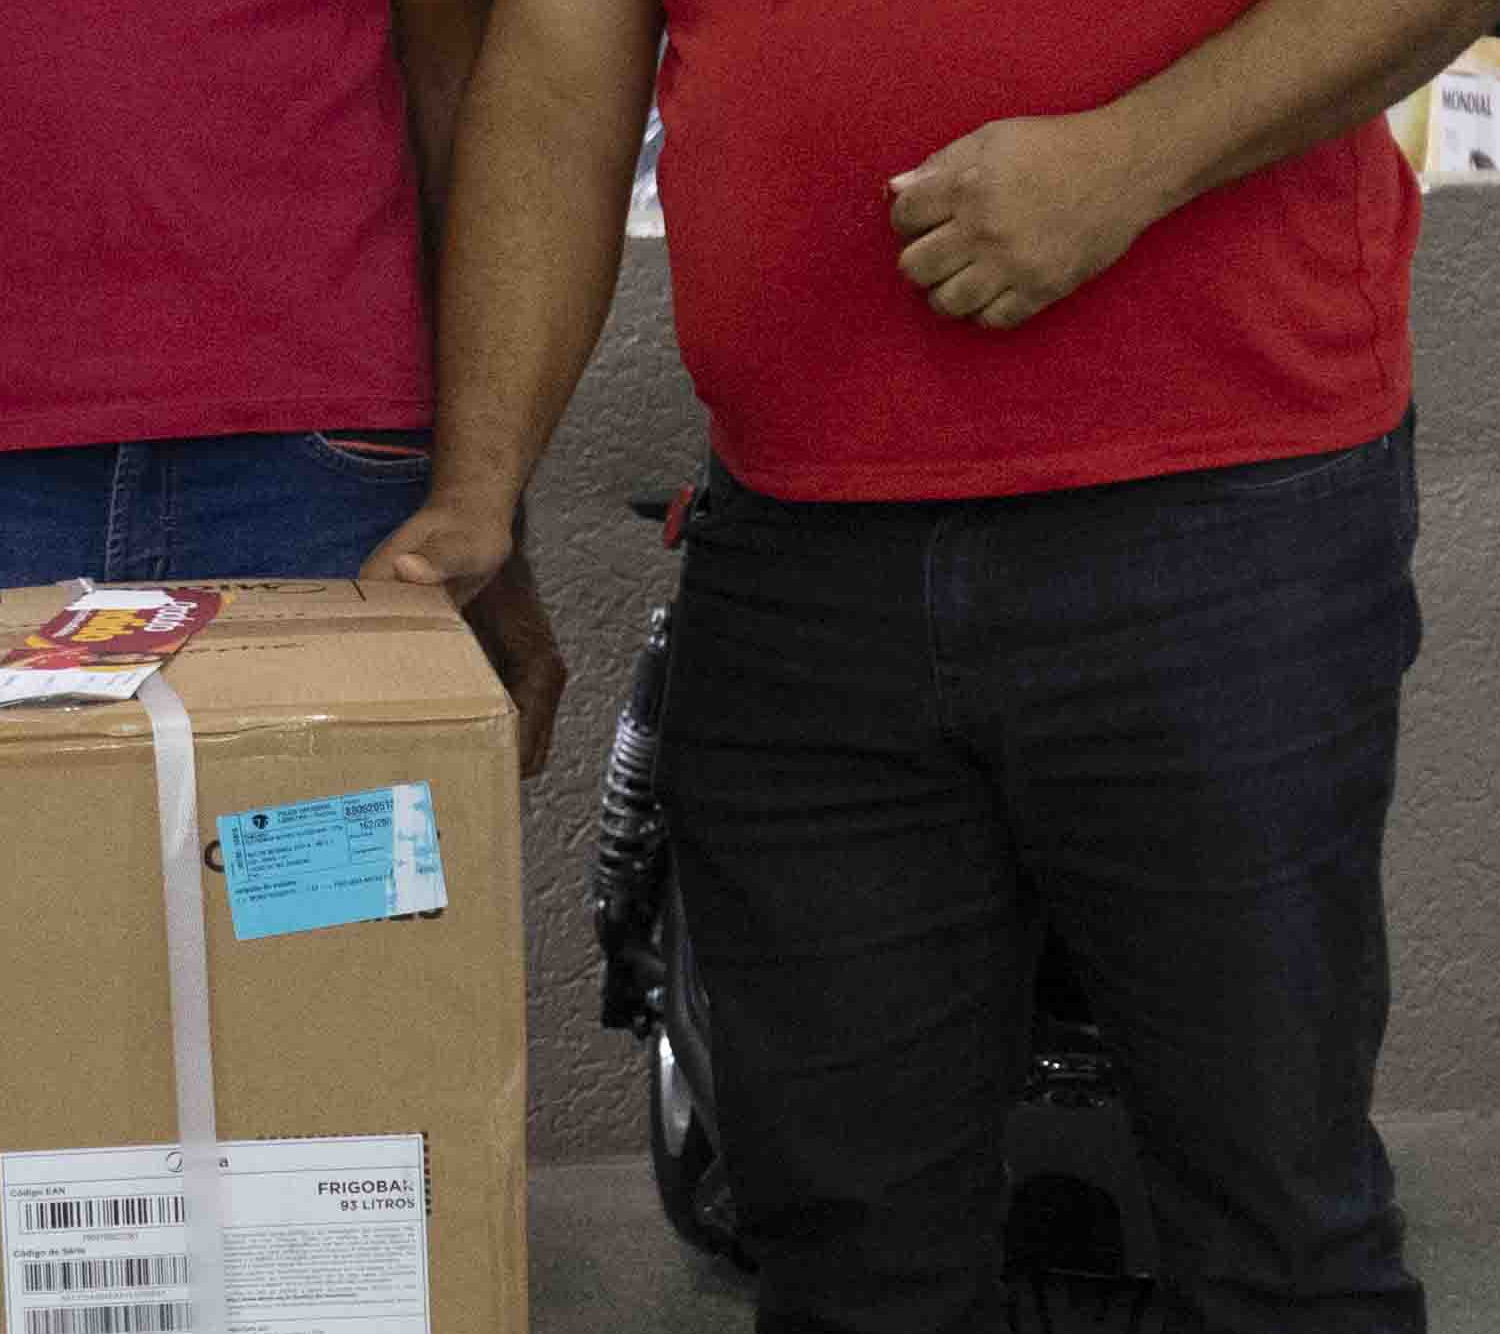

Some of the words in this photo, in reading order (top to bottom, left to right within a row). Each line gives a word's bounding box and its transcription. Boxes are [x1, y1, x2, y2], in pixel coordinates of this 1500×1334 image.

[1441, 89, 1494, 117] MONDIAL
[340, 1199, 358, 1212] 93
[362, 1197, 415, 1210] LITROS
